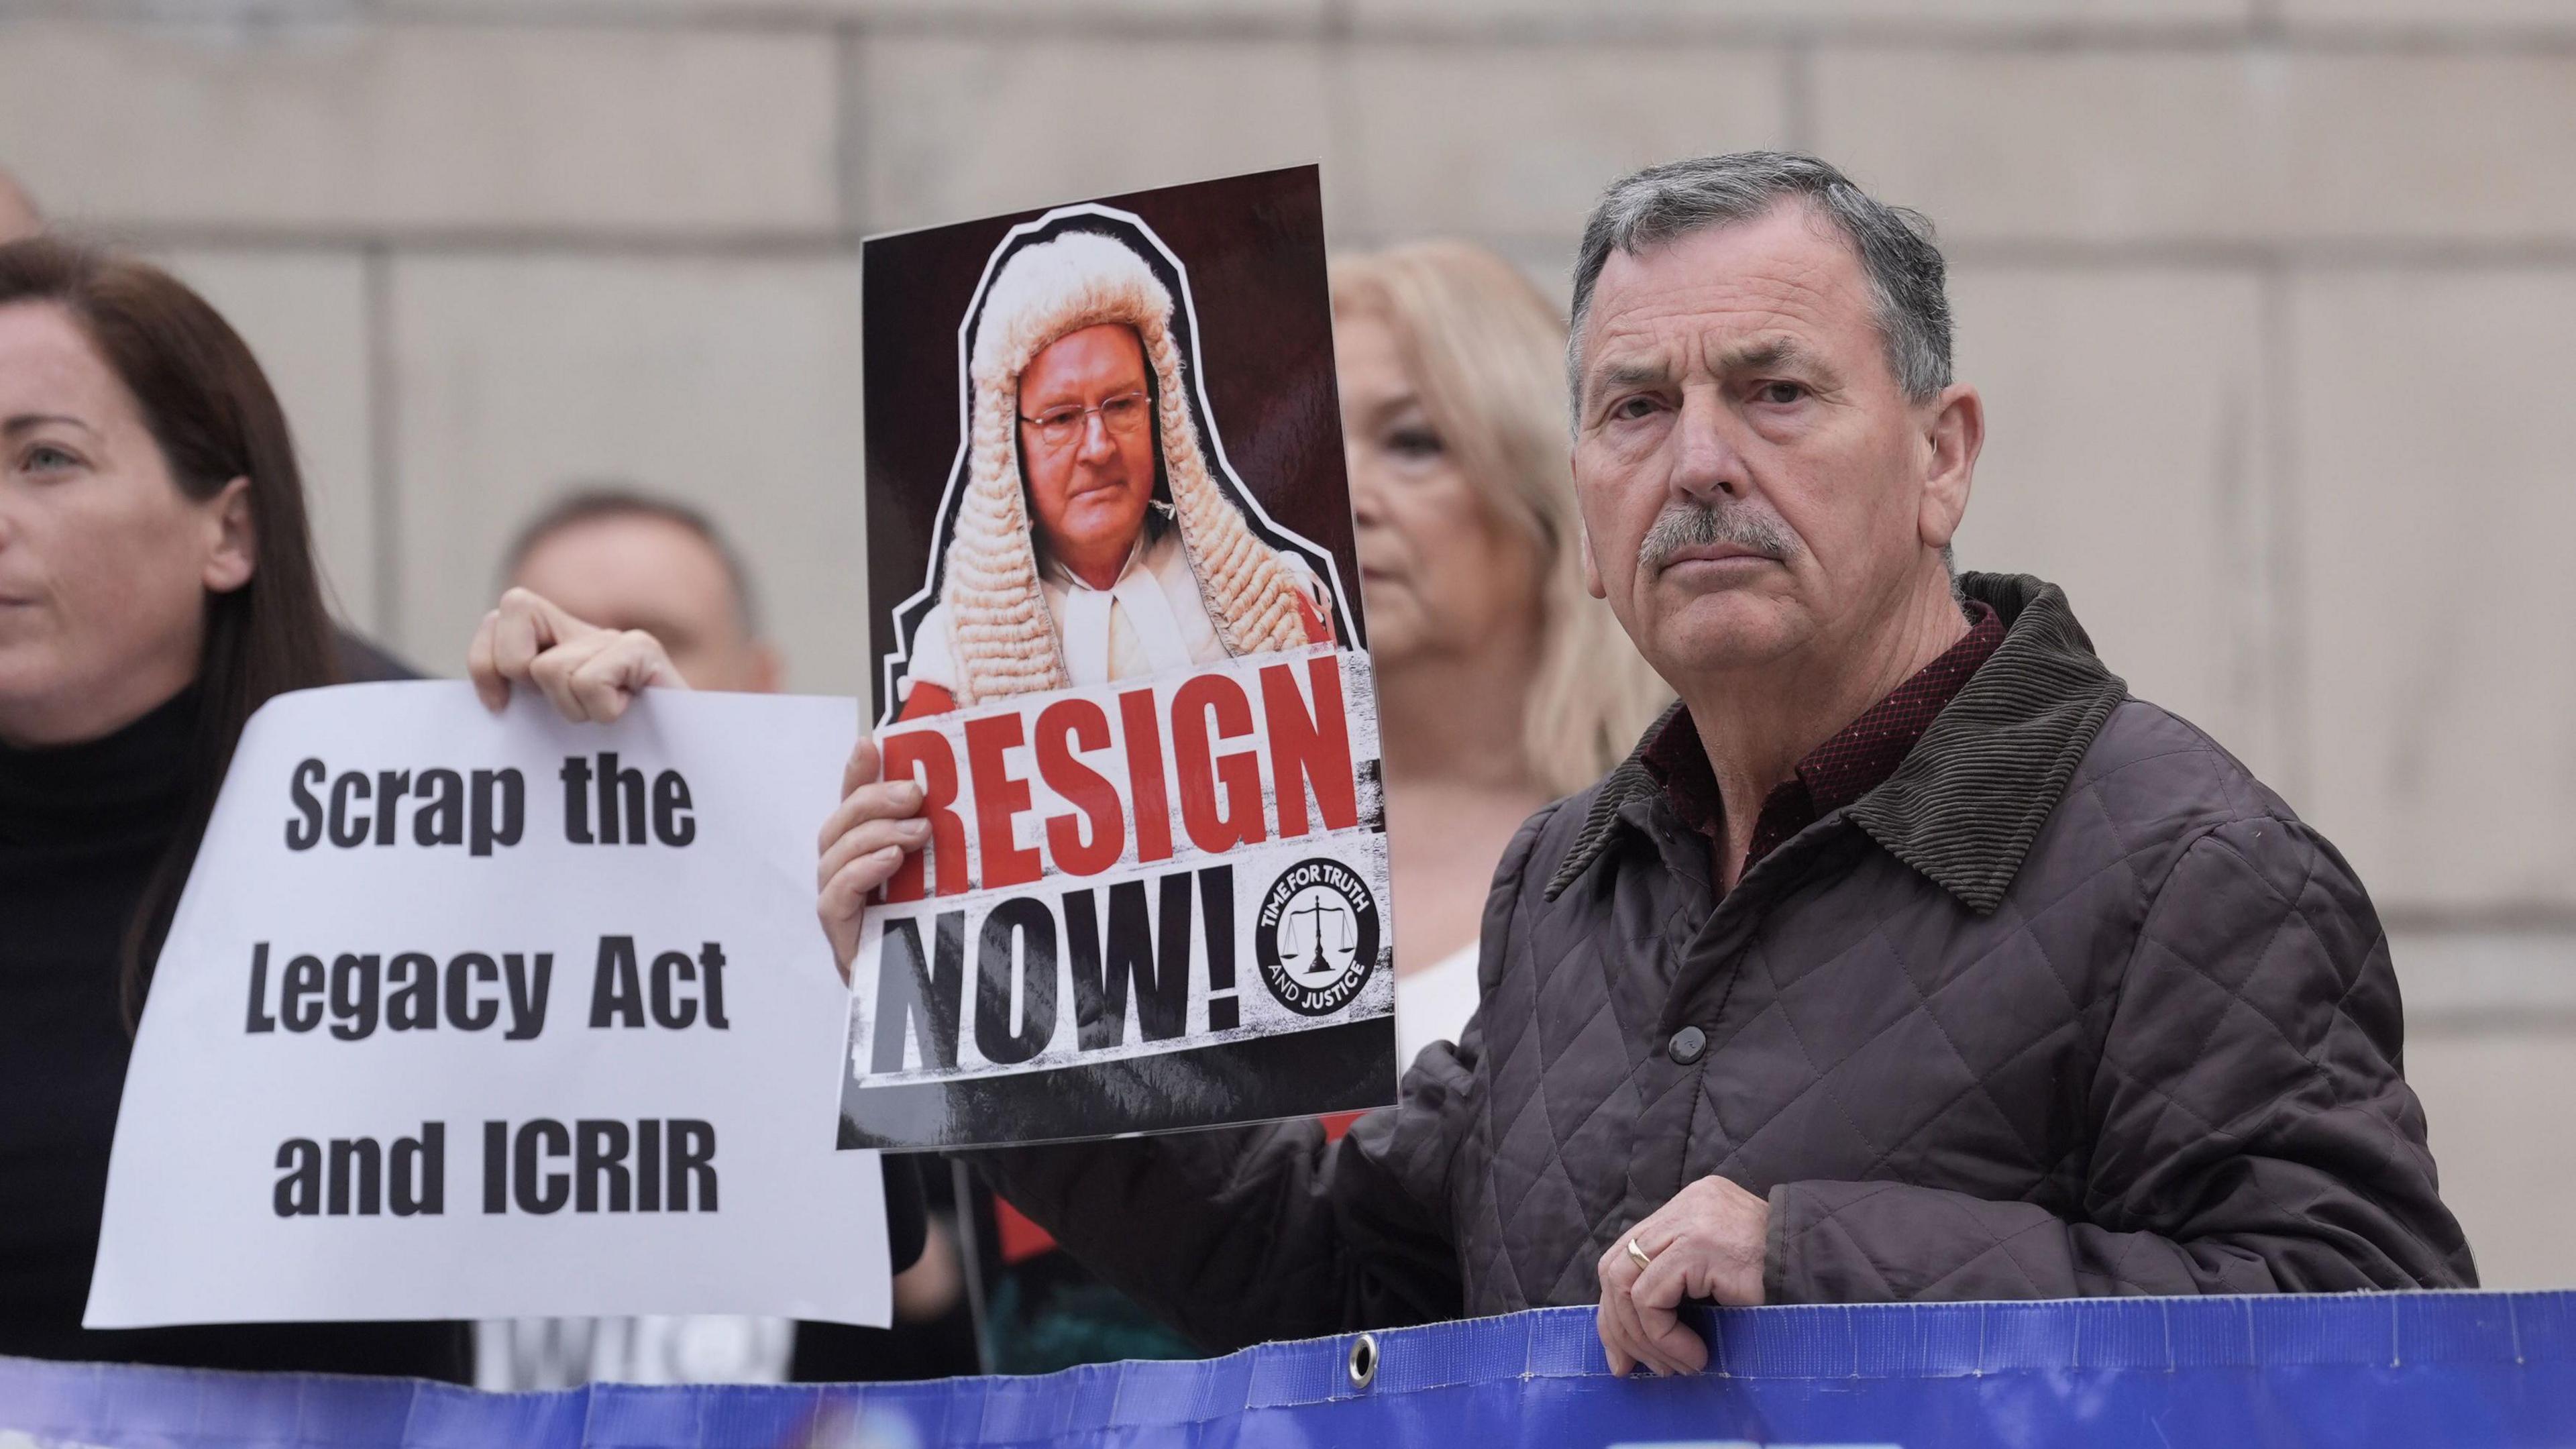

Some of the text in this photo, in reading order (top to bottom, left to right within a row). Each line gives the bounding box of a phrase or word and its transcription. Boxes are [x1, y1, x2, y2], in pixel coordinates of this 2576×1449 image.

[284, 751, 697, 857] Scrap the
[883, 655, 1358, 903] RESIGN
[1261, 865, 1370, 927] TIME FOR TRUTH
[245, 935, 730, 1042] Legacy Act
[870, 863, 1241, 1073] NOW!
[1268, 960, 1365, 1009] AND JUSTICE
[272, 1118, 720, 1218] and ICRIR
